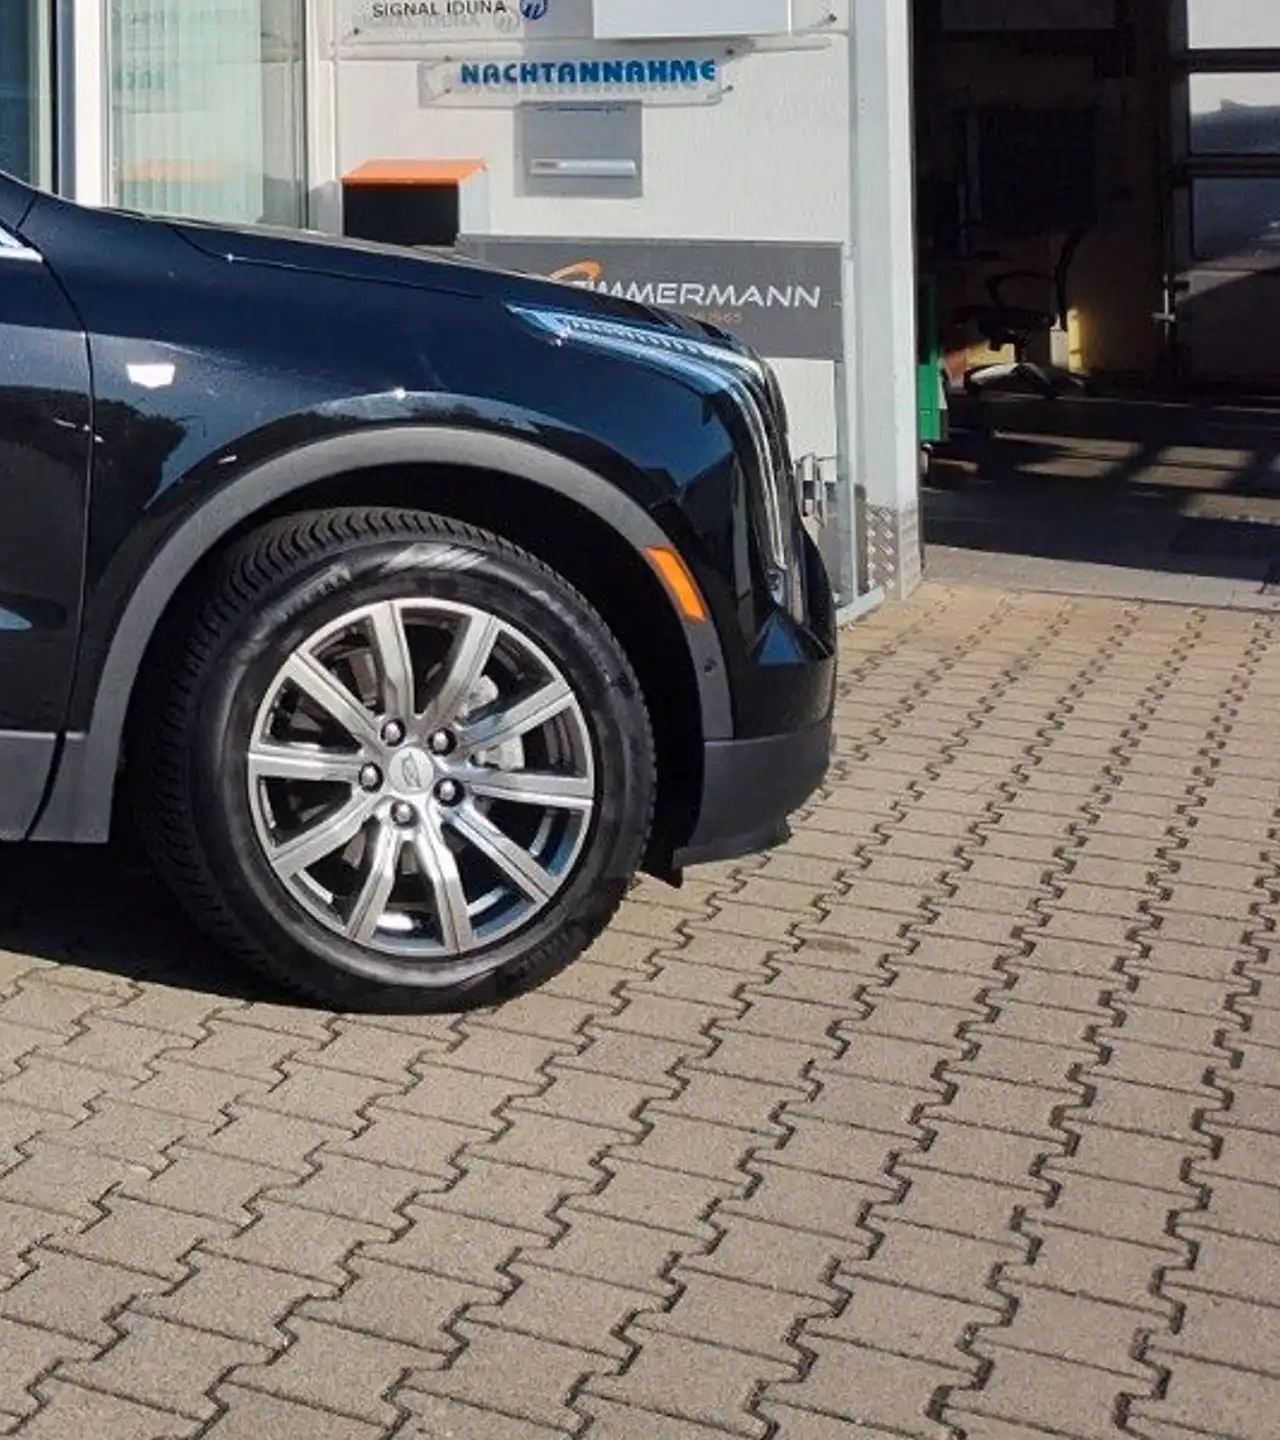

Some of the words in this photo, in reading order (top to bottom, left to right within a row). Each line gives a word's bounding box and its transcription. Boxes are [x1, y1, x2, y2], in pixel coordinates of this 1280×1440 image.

[372, 1, 440, 19] SIGNAL
[447, 0, 508, 15] IDUNA
[460, 57, 717, 87] NACHTANNAHME
